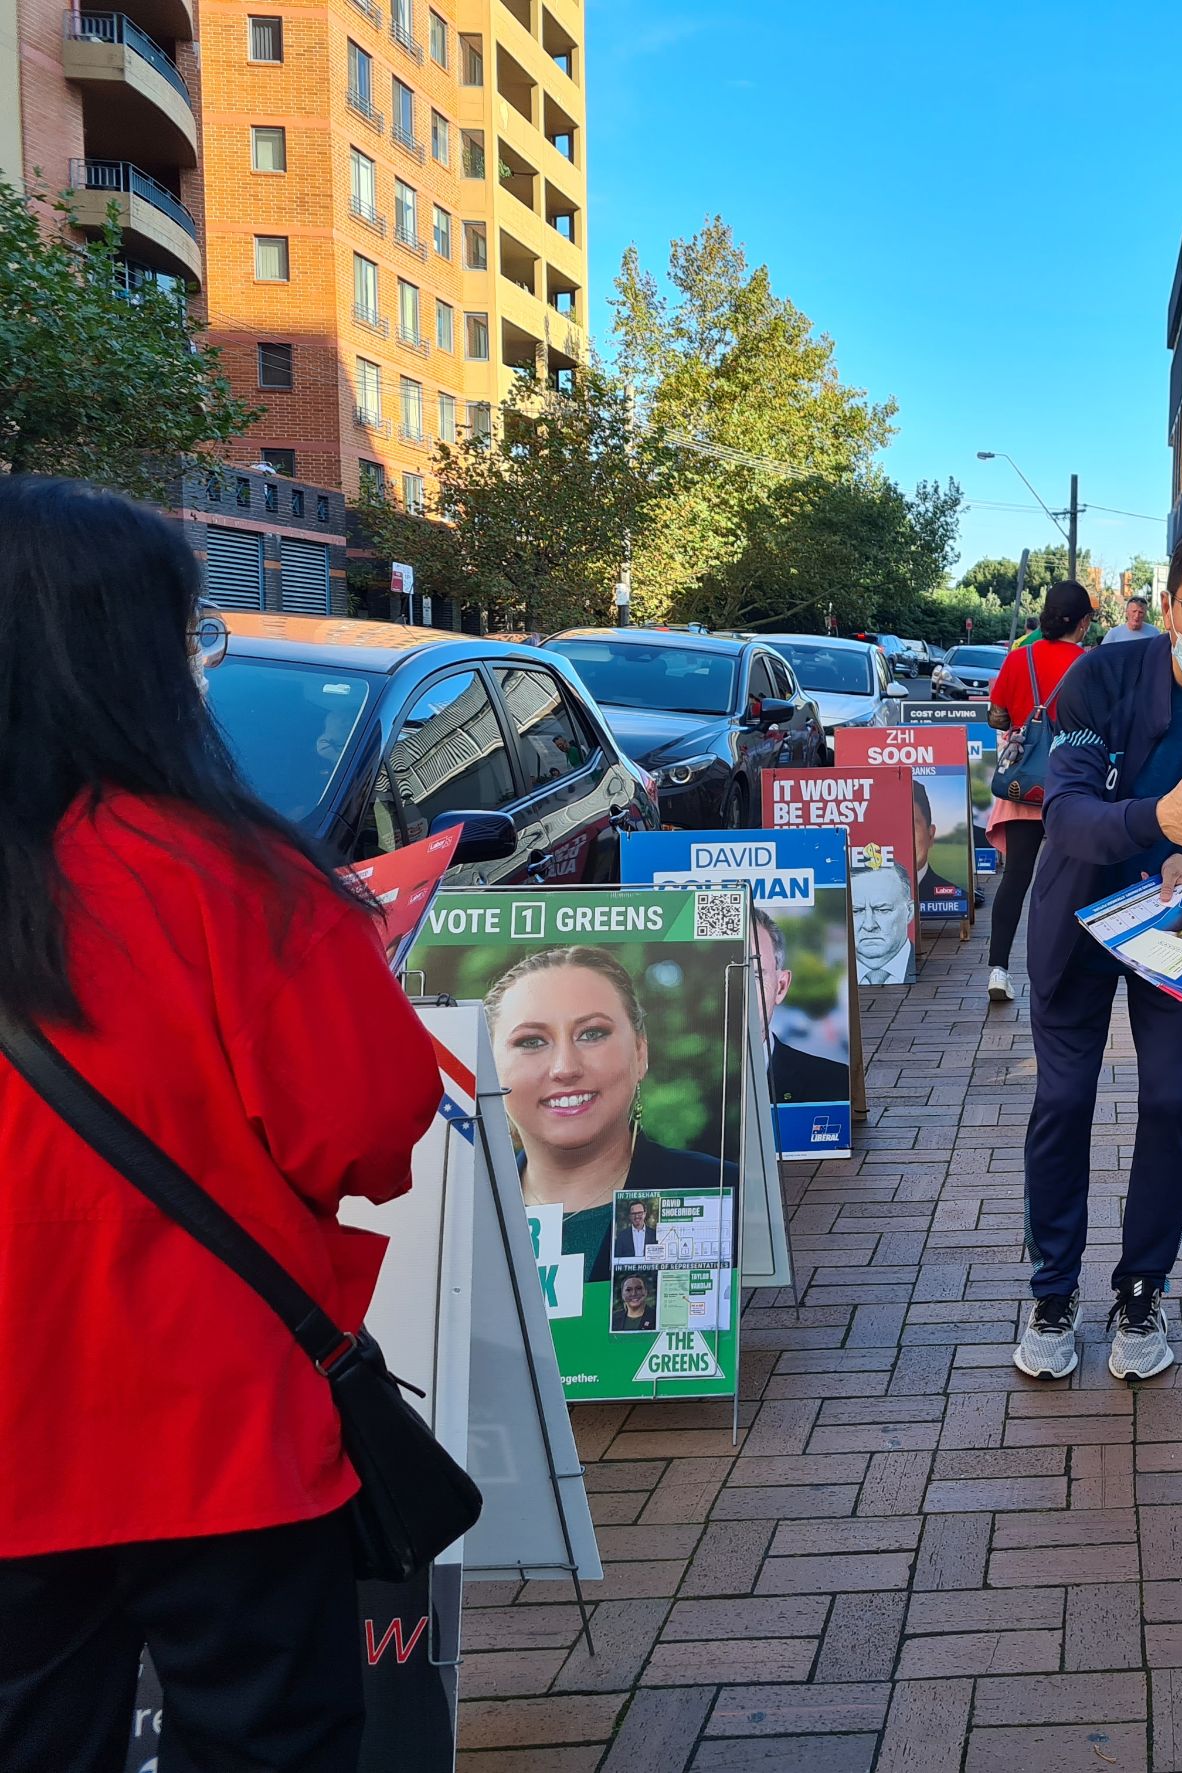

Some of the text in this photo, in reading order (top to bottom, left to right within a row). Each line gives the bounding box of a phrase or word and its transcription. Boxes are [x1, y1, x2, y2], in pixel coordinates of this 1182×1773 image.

[910, 710, 977, 718] COST OF LIVING
[886, 729, 915, 744] ZHI
[867, 746, 934, 765] SOON
[773, 778, 873, 801] IT WON'T
[774, 801, 868, 824] BE EASY
[695, 846, 772, 869] DAVID
[928, 901, 959, 912] FUTURE
[429, 906, 663, 934] VOTE 1 GREENS
[810, 1133, 840, 1142] LIBERAL
[626, 1191, 638, 1199] THE
[661, 1198, 681, 1208] DAVID
[661, 1207, 700, 1217] SHOEBRIDGE
[666, 1332, 695, 1350] THE
[649, 1352, 709, 1373] GREENS
